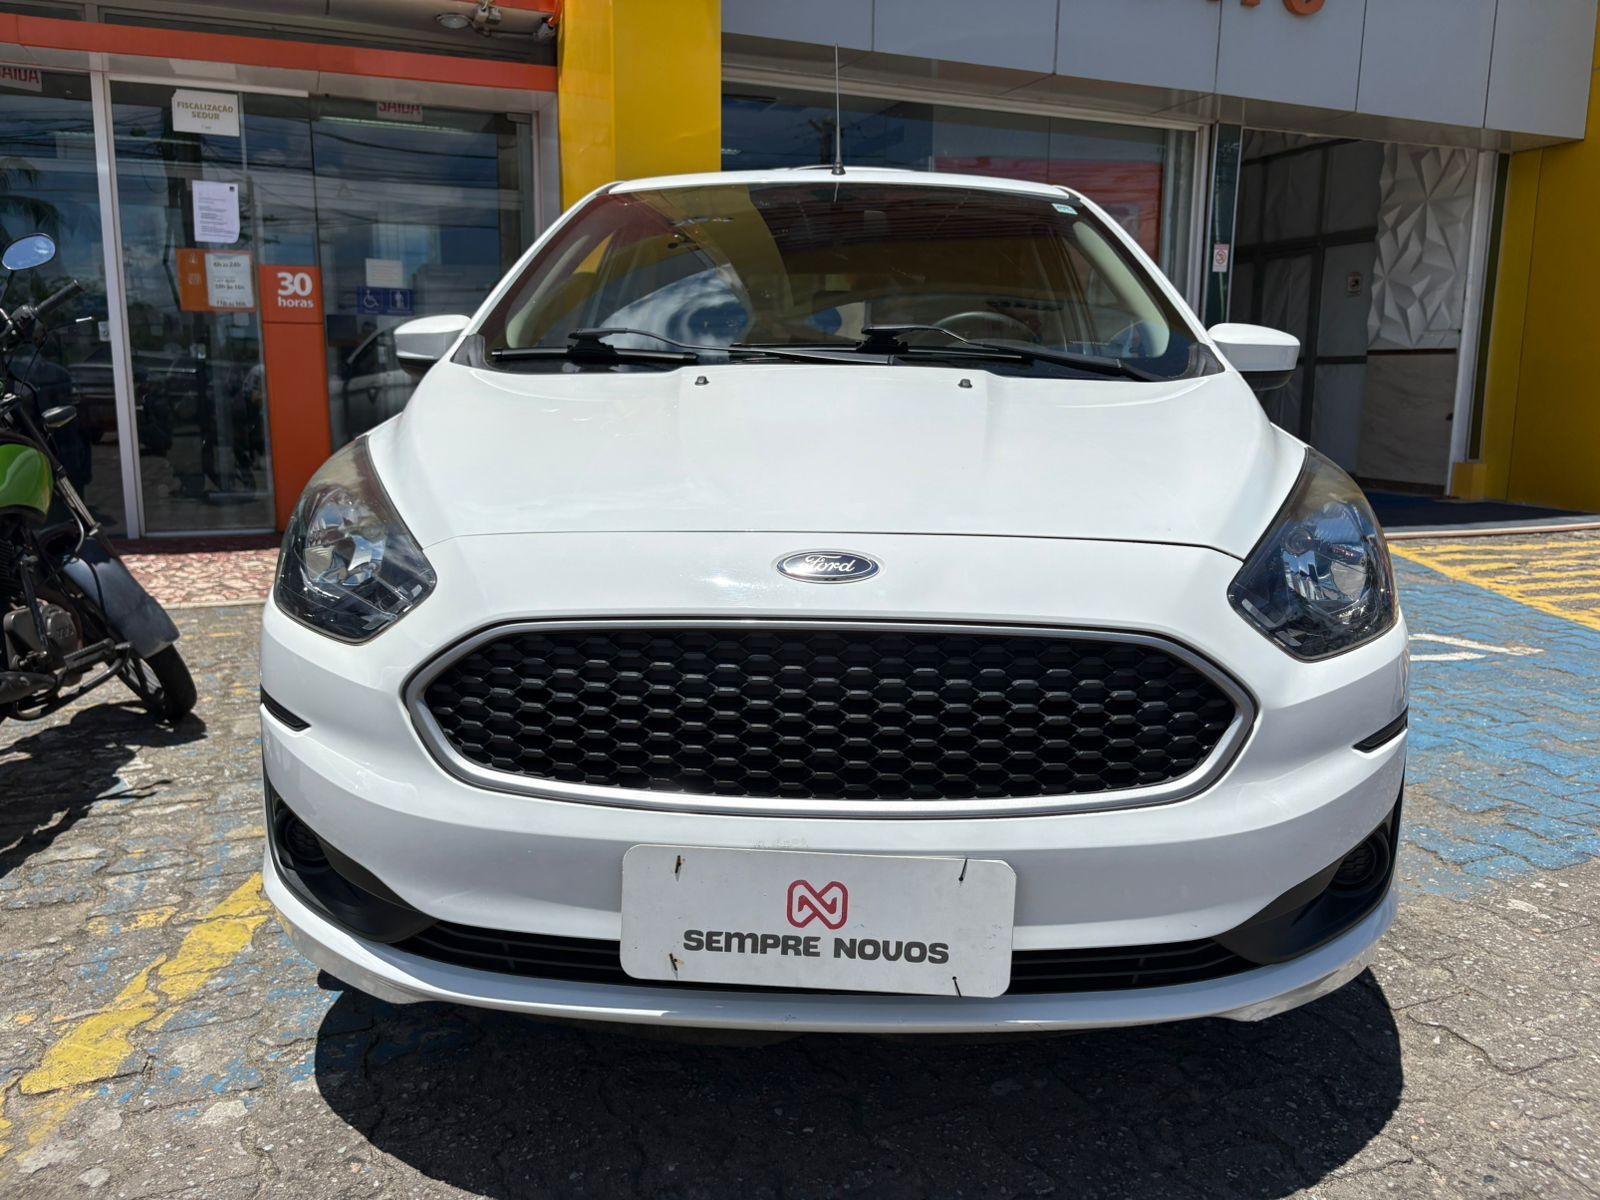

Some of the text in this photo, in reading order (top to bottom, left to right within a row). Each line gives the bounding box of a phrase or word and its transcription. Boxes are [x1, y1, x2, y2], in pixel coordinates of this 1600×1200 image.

[177, 101, 234, 113] FISCALIZAÇÃO
[192, 111, 220, 120] SEDUR
[277, 271, 313, 296] 30
[277, 296, 314, 308] horas
[802, 554, 857, 572] Ford
[683, 928, 949, 965] SEMPRE NOVOS
